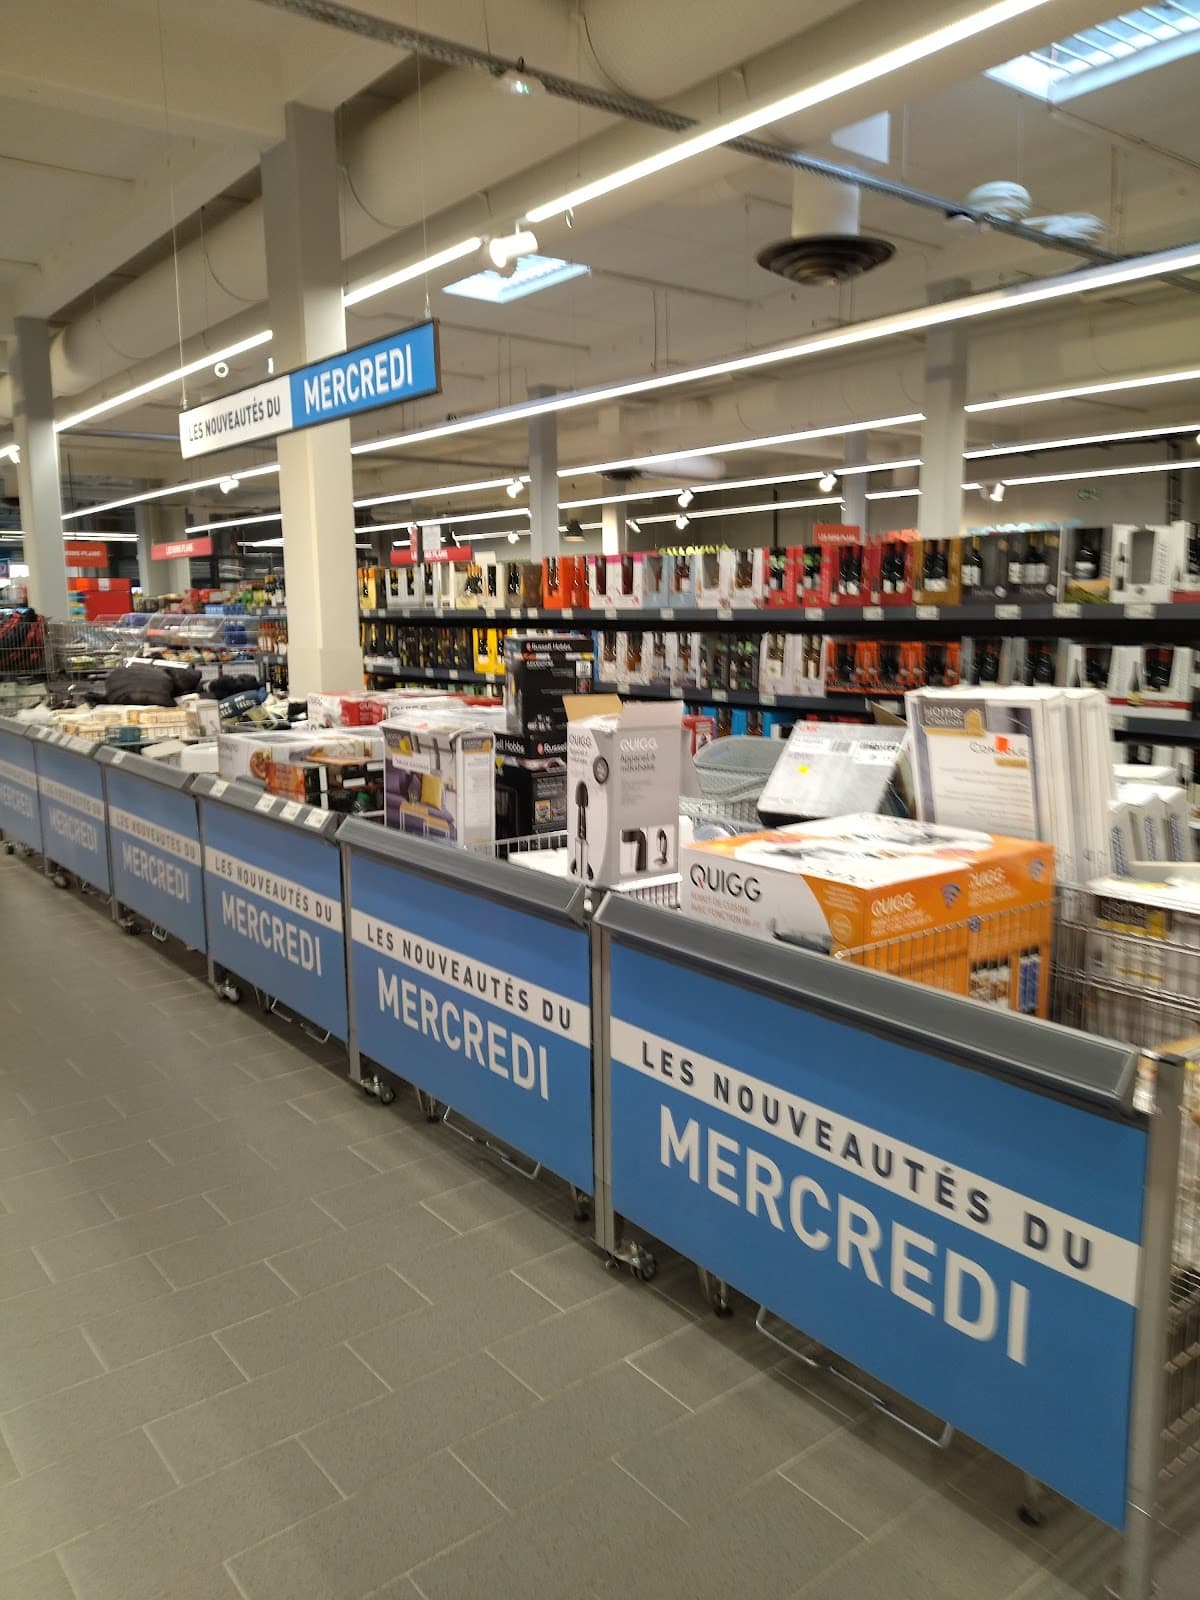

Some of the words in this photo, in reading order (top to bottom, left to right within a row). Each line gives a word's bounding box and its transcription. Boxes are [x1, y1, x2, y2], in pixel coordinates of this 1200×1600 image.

[188, 422, 203, 442] LES
[205, 396, 264, 436] NOUVEAUTÉS
[267, 396, 280, 418] DU
[304, 343, 413, 414] MERCREDI
[569, 735, 592, 748] QUIGG
[924, 705, 963, 718] Home
[505, 739, 525, 755] Hobbs
[619, 736, 658, 753] QUIGG
[122, 841, 190, 904] MERCREDI
[215, 855, 234, 877] LES
[237, 862, 309, 912] NOUVEAUTÉS
[315, 901, 333, 923] DU
[690, 863, 762, 902] QUIGG
[871, 892, 915, 917] QUIGG
[222, 890, 322, 976] MERCREDI
[367, 923, 394, 951] LES
[402, 939, 528, 1012] NOUVEAUTÉS
[542, 999, 571, 1030] DU
[377, 968, 549, 1101] MERCREDI
[641, 1041, 696, 1086] LES
[713, 1072, 991, 1223] NOUVEAUTÉS
[1023, 1212, 1093, 1271] DU
[659, 1104, 1030, 1367] MERCREDI
